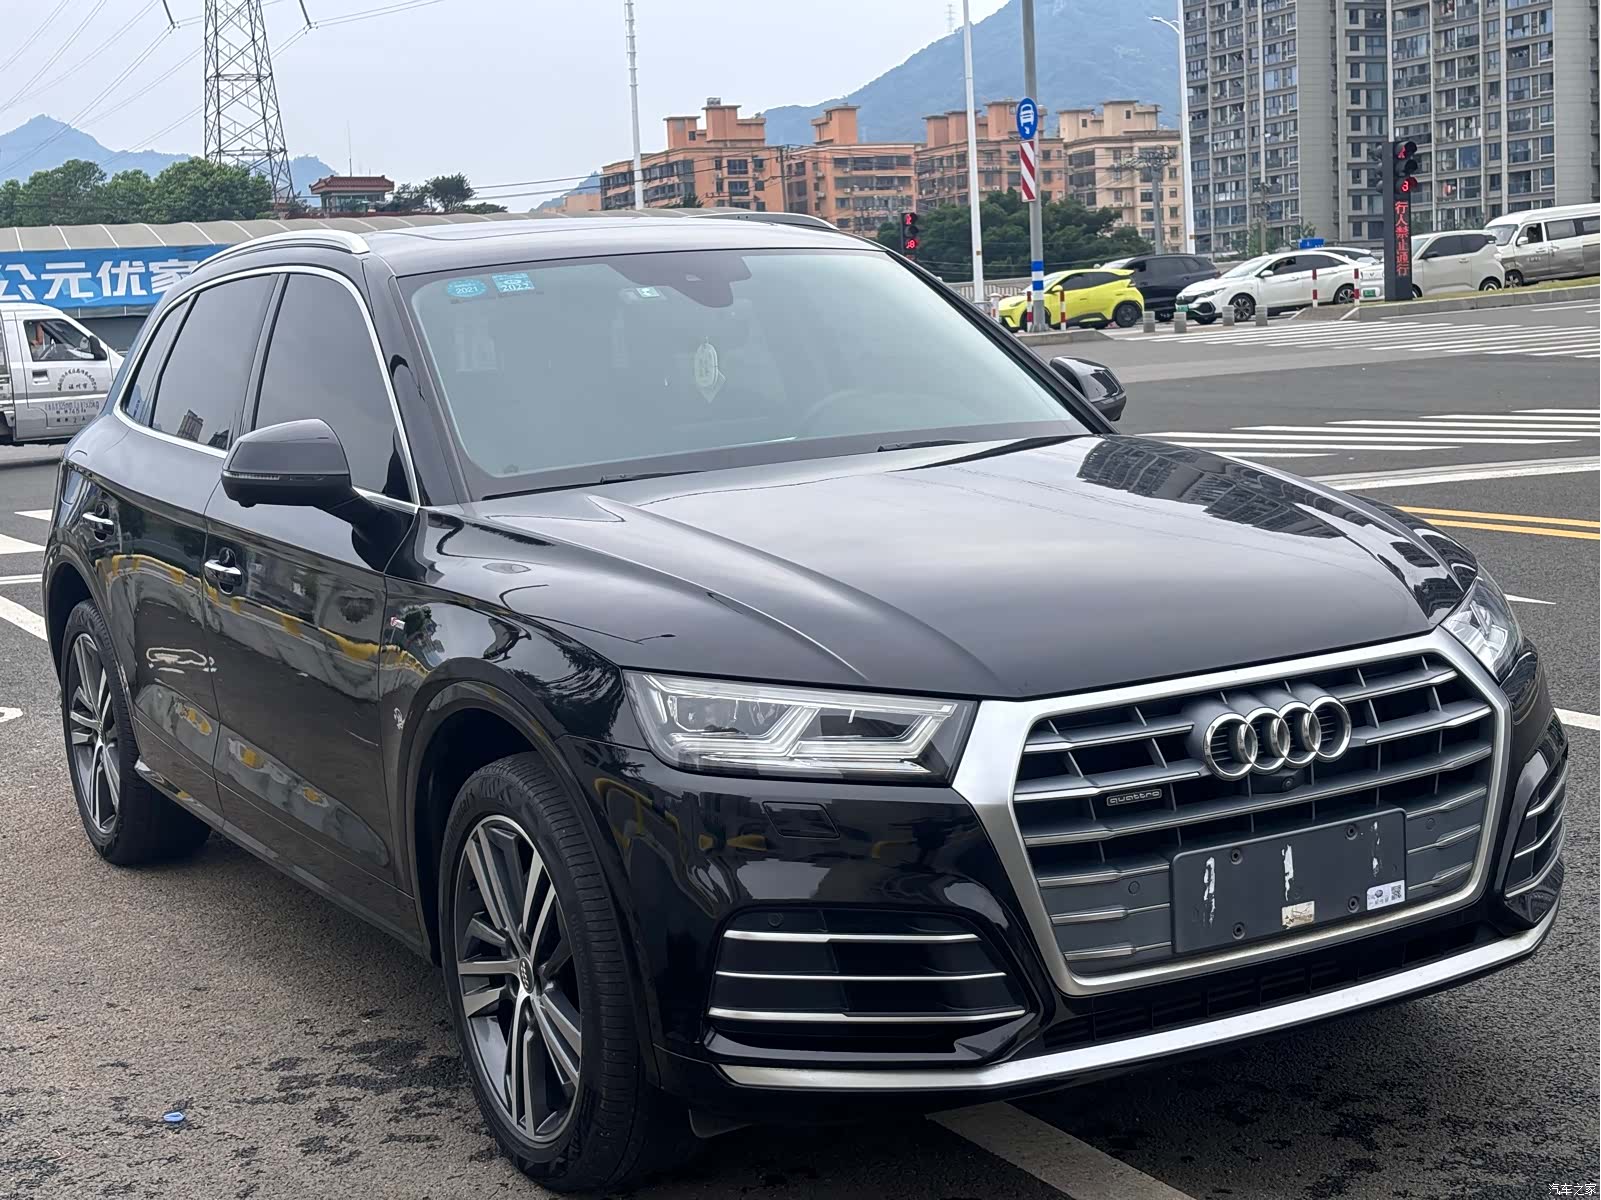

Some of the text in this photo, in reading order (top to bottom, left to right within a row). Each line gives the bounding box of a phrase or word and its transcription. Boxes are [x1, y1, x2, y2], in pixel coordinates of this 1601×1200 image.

[1395, 201, 1409, 277] 行人禁止通行
[456, 286, 478, 294] 2021
[1109, 791, 1160, 805] quattro
